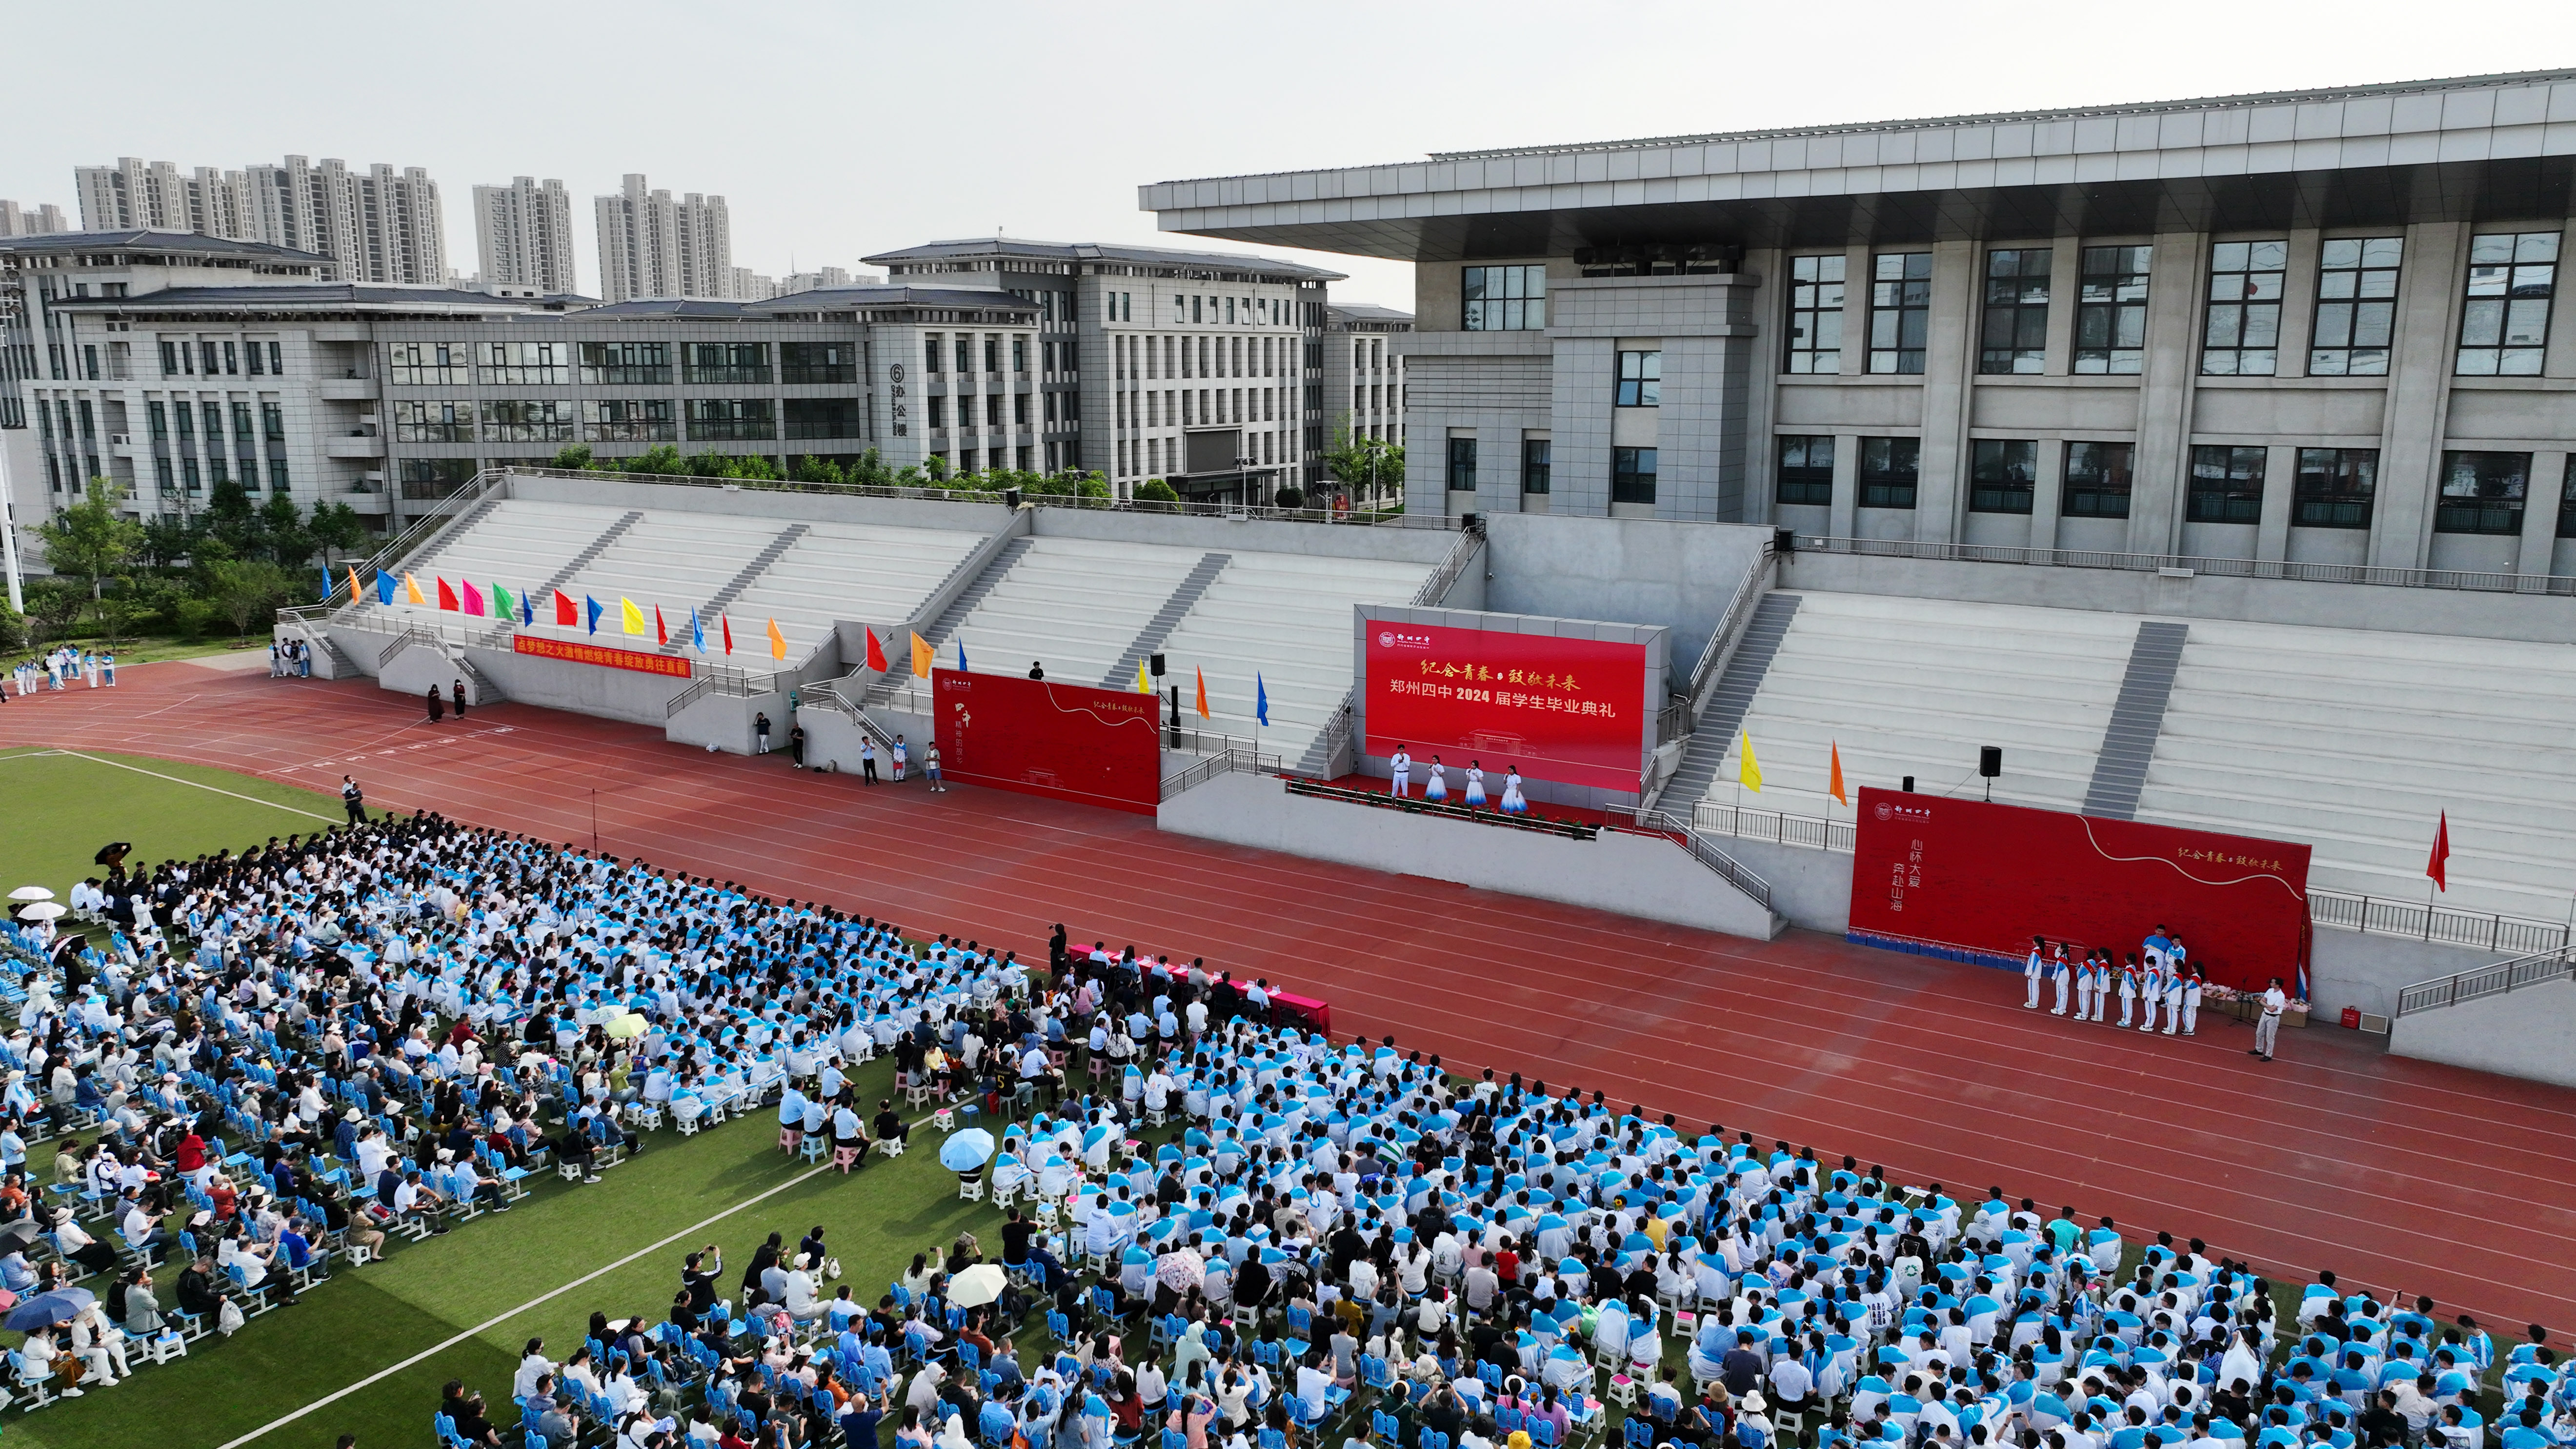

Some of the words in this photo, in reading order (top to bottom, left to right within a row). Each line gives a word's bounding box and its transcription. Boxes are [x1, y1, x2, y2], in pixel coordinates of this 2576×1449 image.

[896, 385, 906, 437] 办公楼
[518, 638, 686, 675] 点梦想之火激情燃烧青春绽放勇往直前
[1421, 659, 1493, 681] 纪念青春
[1509, 669, 1581, 691] 致敬未来
[1390, 679, 1452, 699] 郑州四中
[1456, 687, 1490, 703] 2024
[1495, 691, 1616, 718] 届学生毕业典礼
[1908, 839, 1923, 888] 心怀大爱
[1890, 863, 1905, 911] 奔赴山海
[1297, 1052, 1303, 1061] 7
[998, 1075, 1005, 1089] 5
